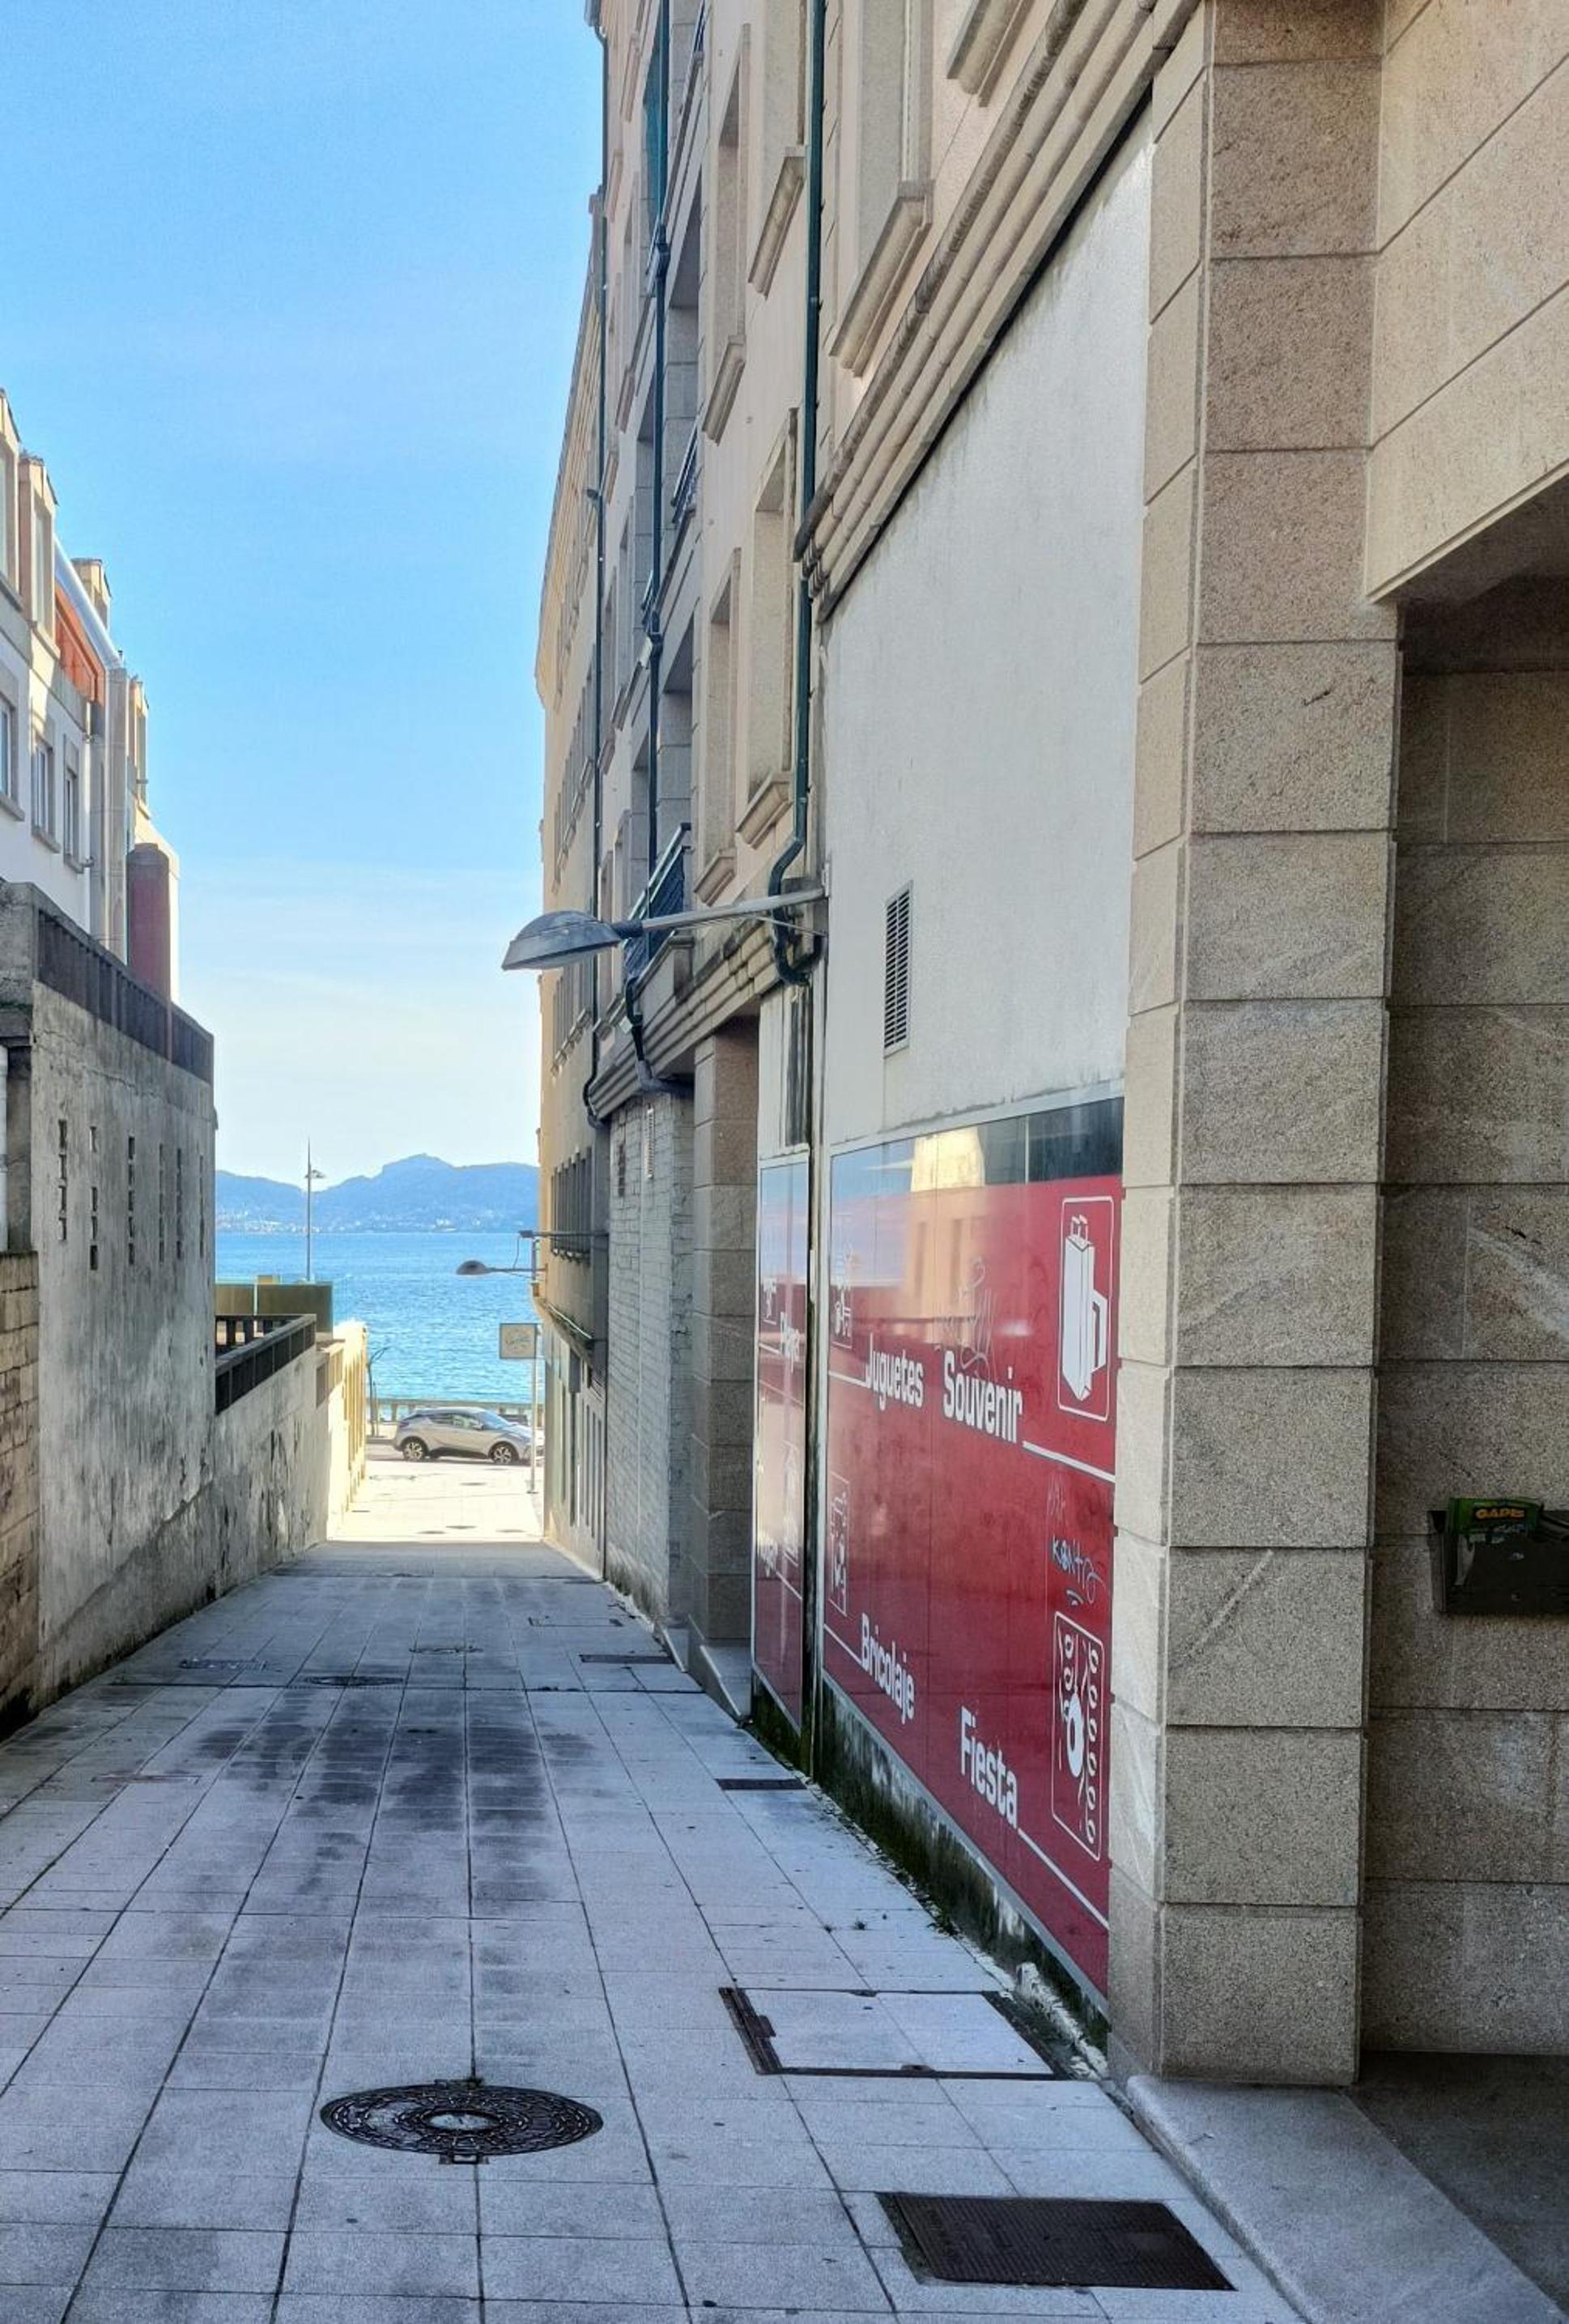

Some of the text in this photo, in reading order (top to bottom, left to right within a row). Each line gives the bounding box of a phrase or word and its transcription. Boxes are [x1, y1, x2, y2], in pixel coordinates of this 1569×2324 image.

[865, 1332, 924, 1411] Juguetes
[943, 1350, 1023, 1444] Souvenir
[861, 1613, 915, 1724] Bricolaje
[960, 1705, 1018, 1828] Fiesta
